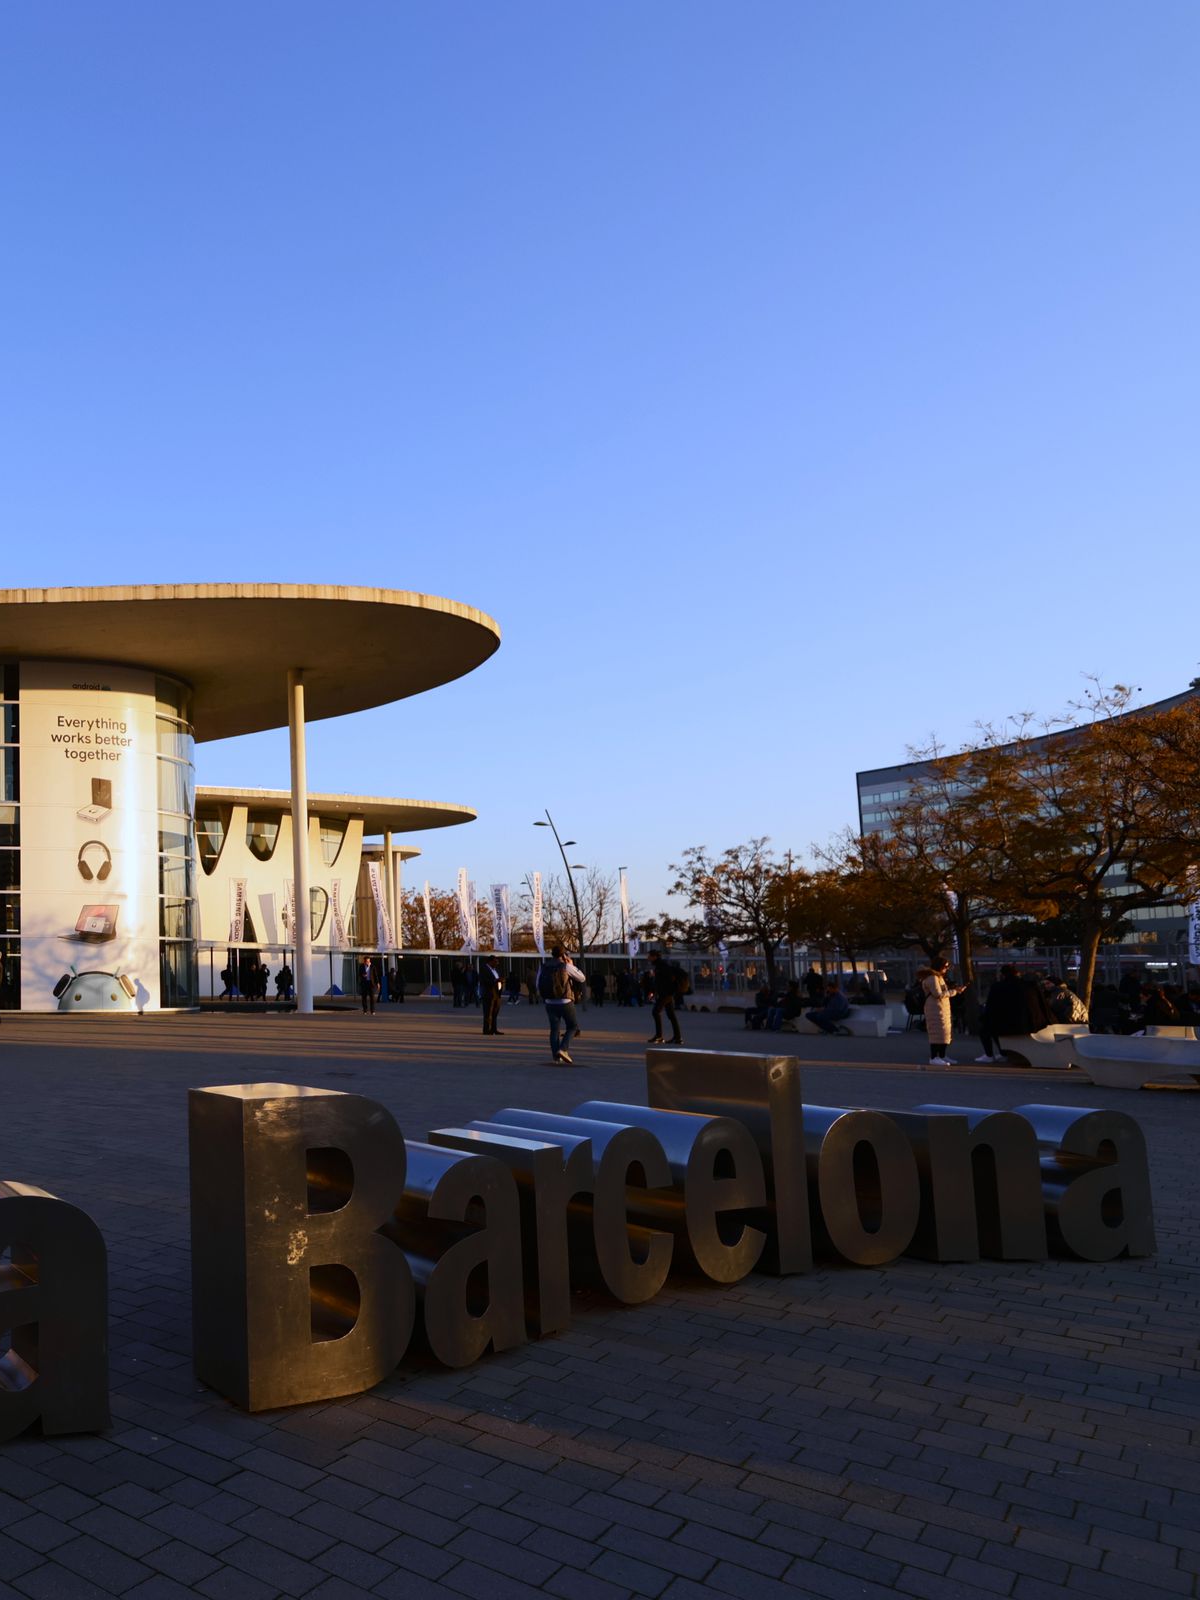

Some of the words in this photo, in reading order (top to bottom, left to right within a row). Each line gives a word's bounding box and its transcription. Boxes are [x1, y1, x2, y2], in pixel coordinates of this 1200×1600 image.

[57, 715, 127, 734] Everything
[51, 732, 91, 744] works
[94, 733, 133, 746] better
[64, 748, 122, 762] together
[235, 882, 243, 917] SAMSUNG
[188, 1048, 1157, 1412] Barcelona
